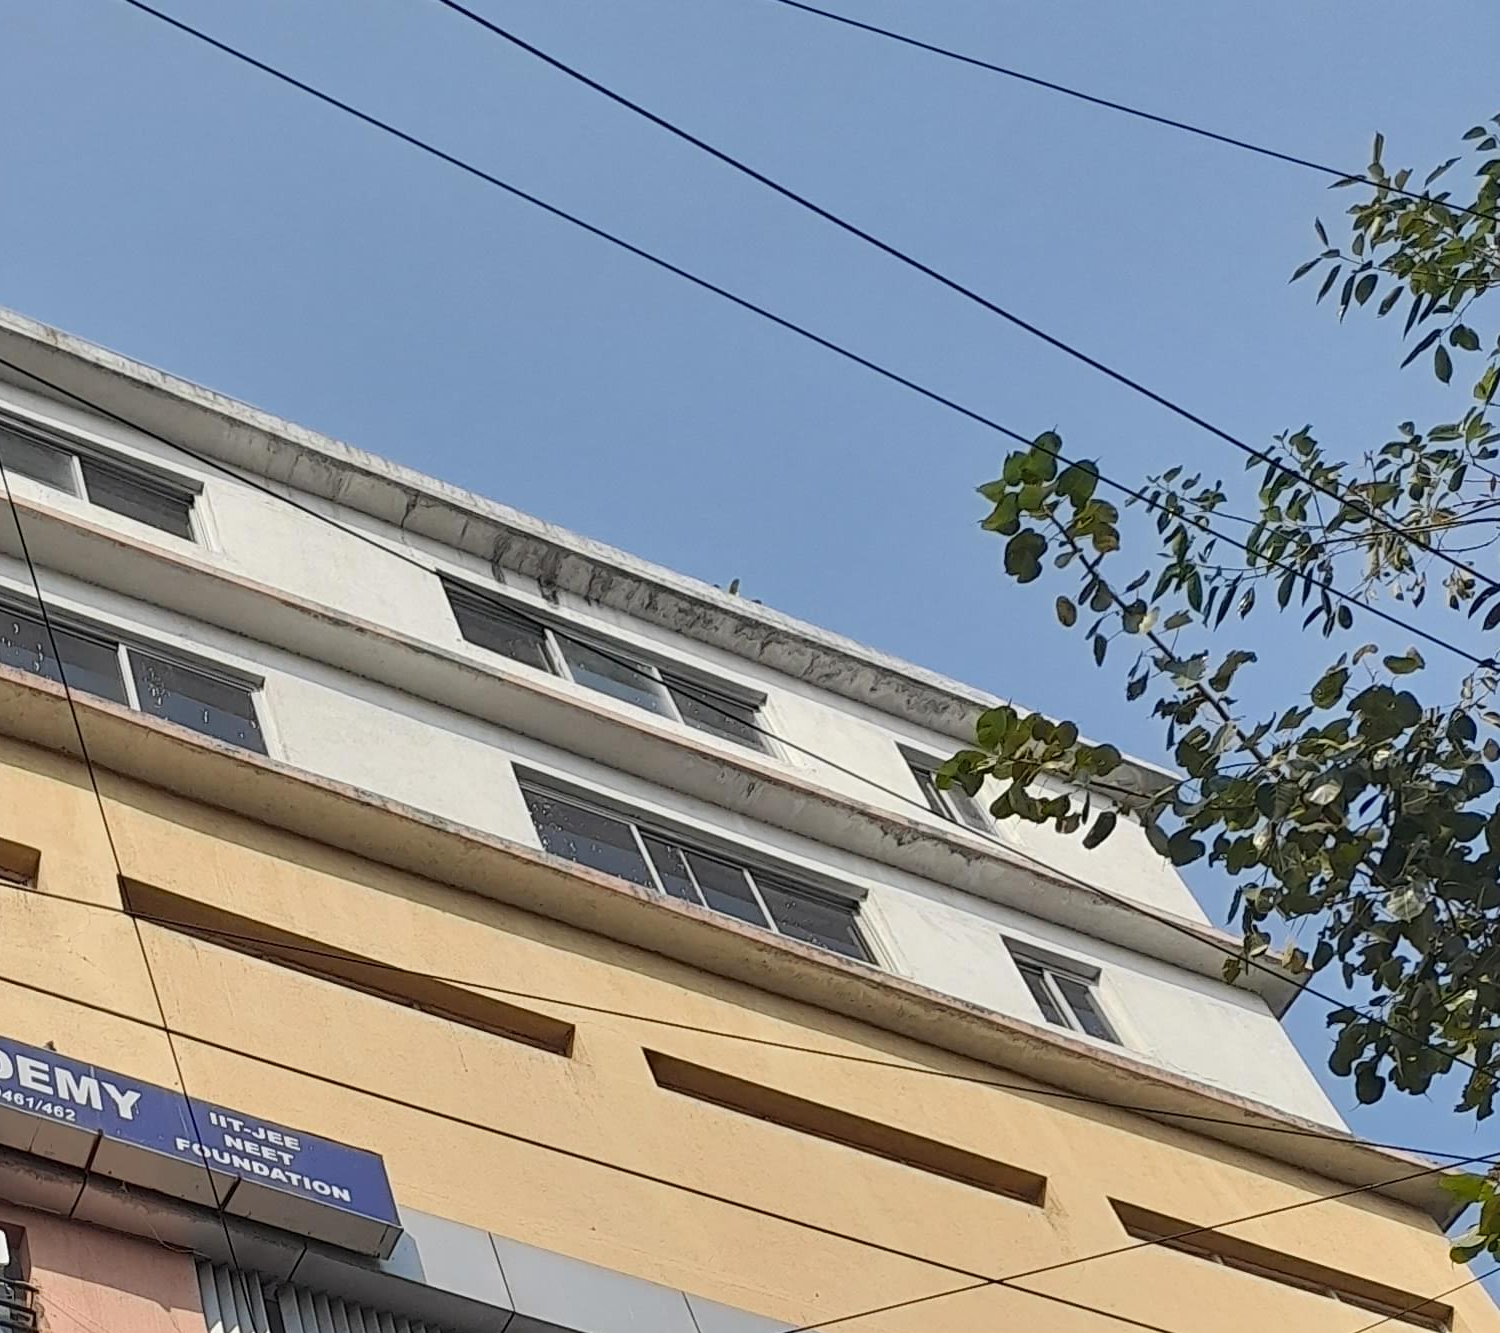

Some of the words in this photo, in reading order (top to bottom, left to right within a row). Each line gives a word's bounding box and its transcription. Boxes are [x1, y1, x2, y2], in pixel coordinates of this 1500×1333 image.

[209, 1112, 300, 1150] IIT-JEE
[224, 1134, 294, 1166] NEET
[175, 1138, 351, 1202] FOUNDATION
